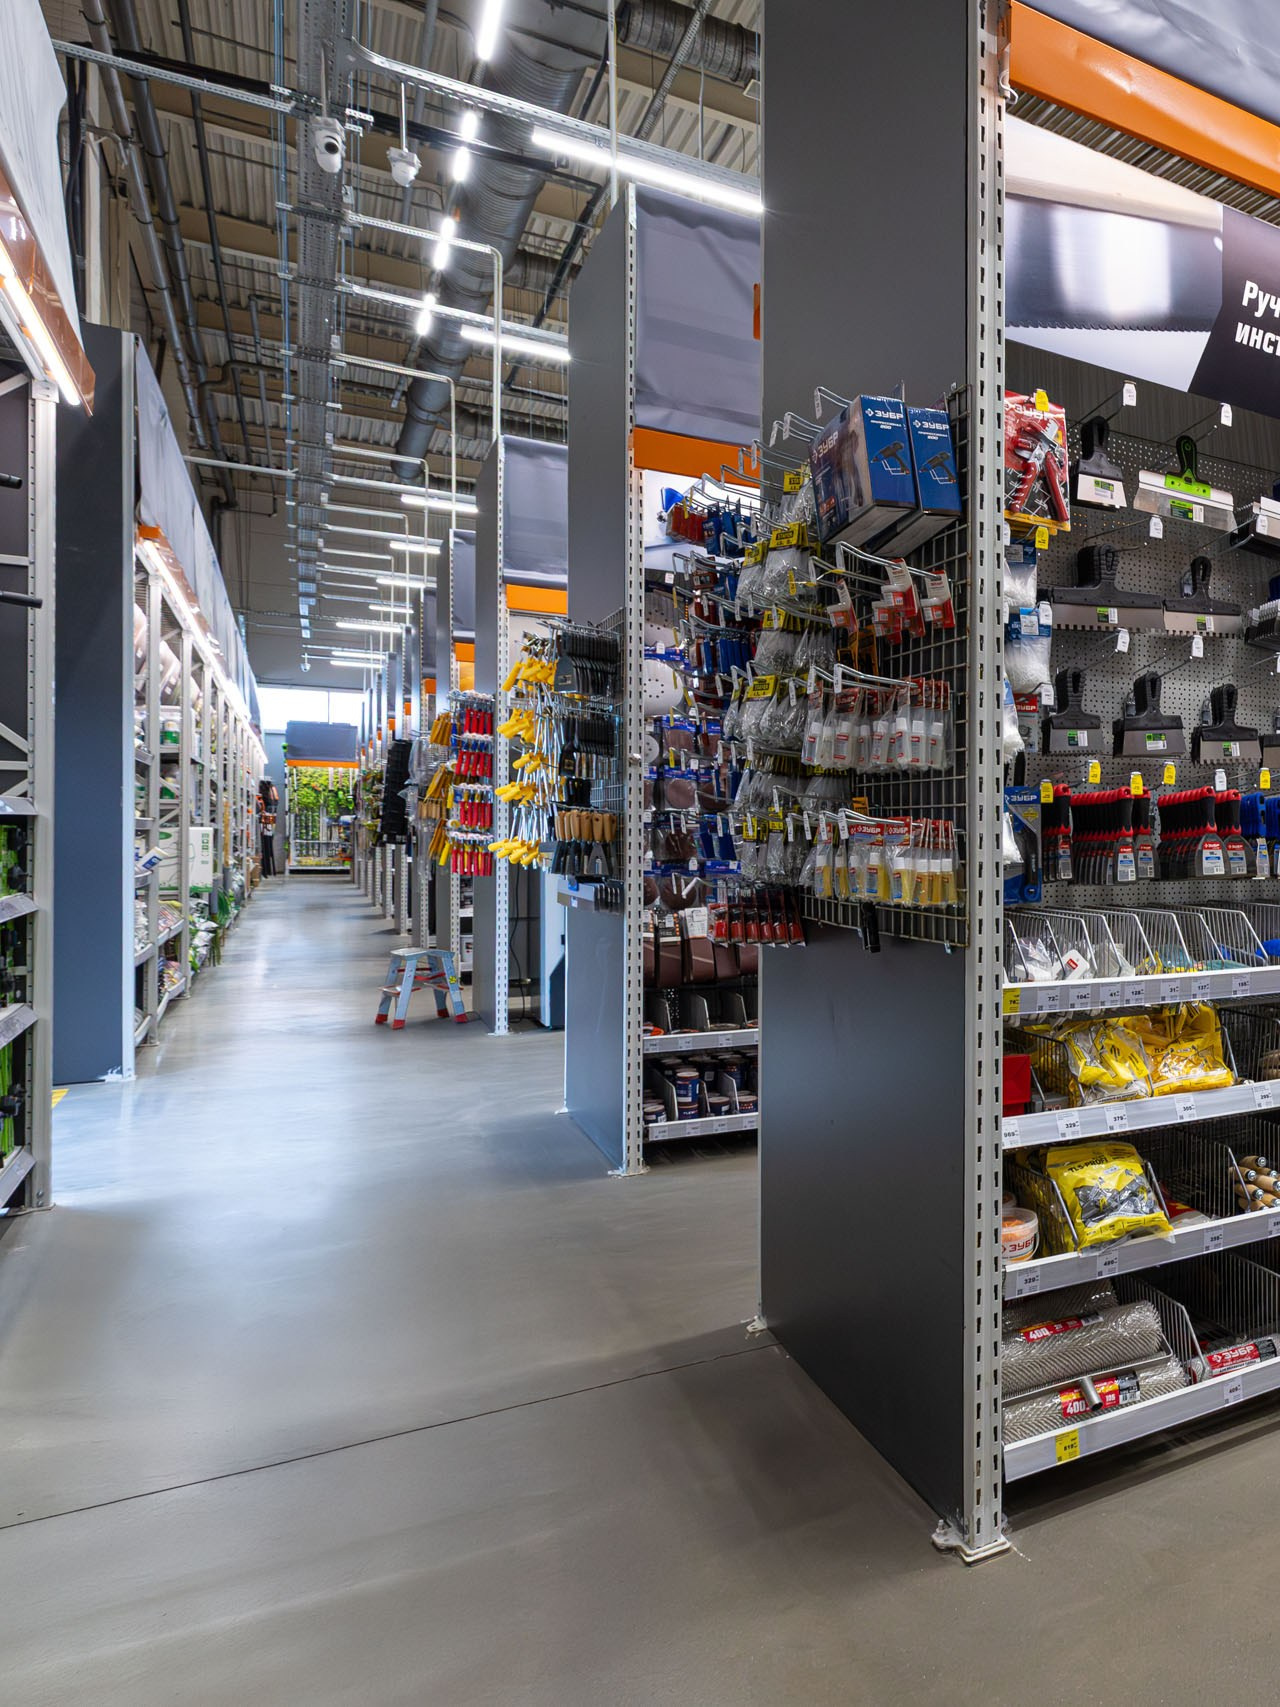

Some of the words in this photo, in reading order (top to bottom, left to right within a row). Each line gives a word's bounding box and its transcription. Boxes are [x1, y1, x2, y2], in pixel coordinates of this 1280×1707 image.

[875, 409, 904, 420] ЗУБР
[922, 420, 950, 431] ЗУБР
[817, 431, 838, 458] ЗУБР
[862, 825, 881, 834] ЗУБР
[892, 826, 909, 835] ЗУБР
[1029, 1327, 1050, 1339] 400
[1224, 1345, 1255, 1360] ЗУБР
[1067, 1400, 1086, 1414] 400
